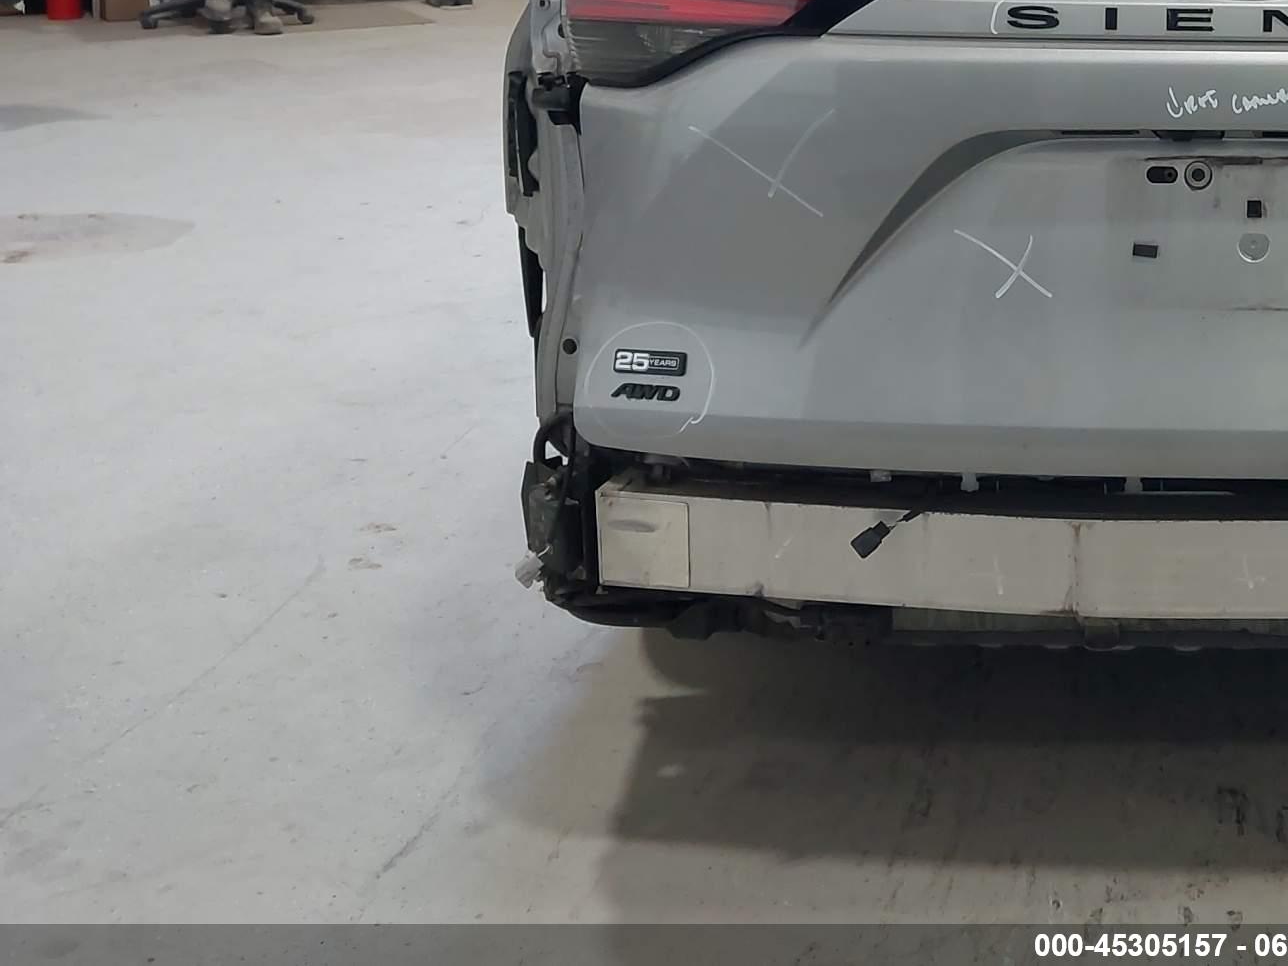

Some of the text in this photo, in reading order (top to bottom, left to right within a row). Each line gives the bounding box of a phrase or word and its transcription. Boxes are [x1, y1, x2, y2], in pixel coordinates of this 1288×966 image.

[614, 351, 678, 372] 25 YEARS
[610, 382, 681, 402] AWD
